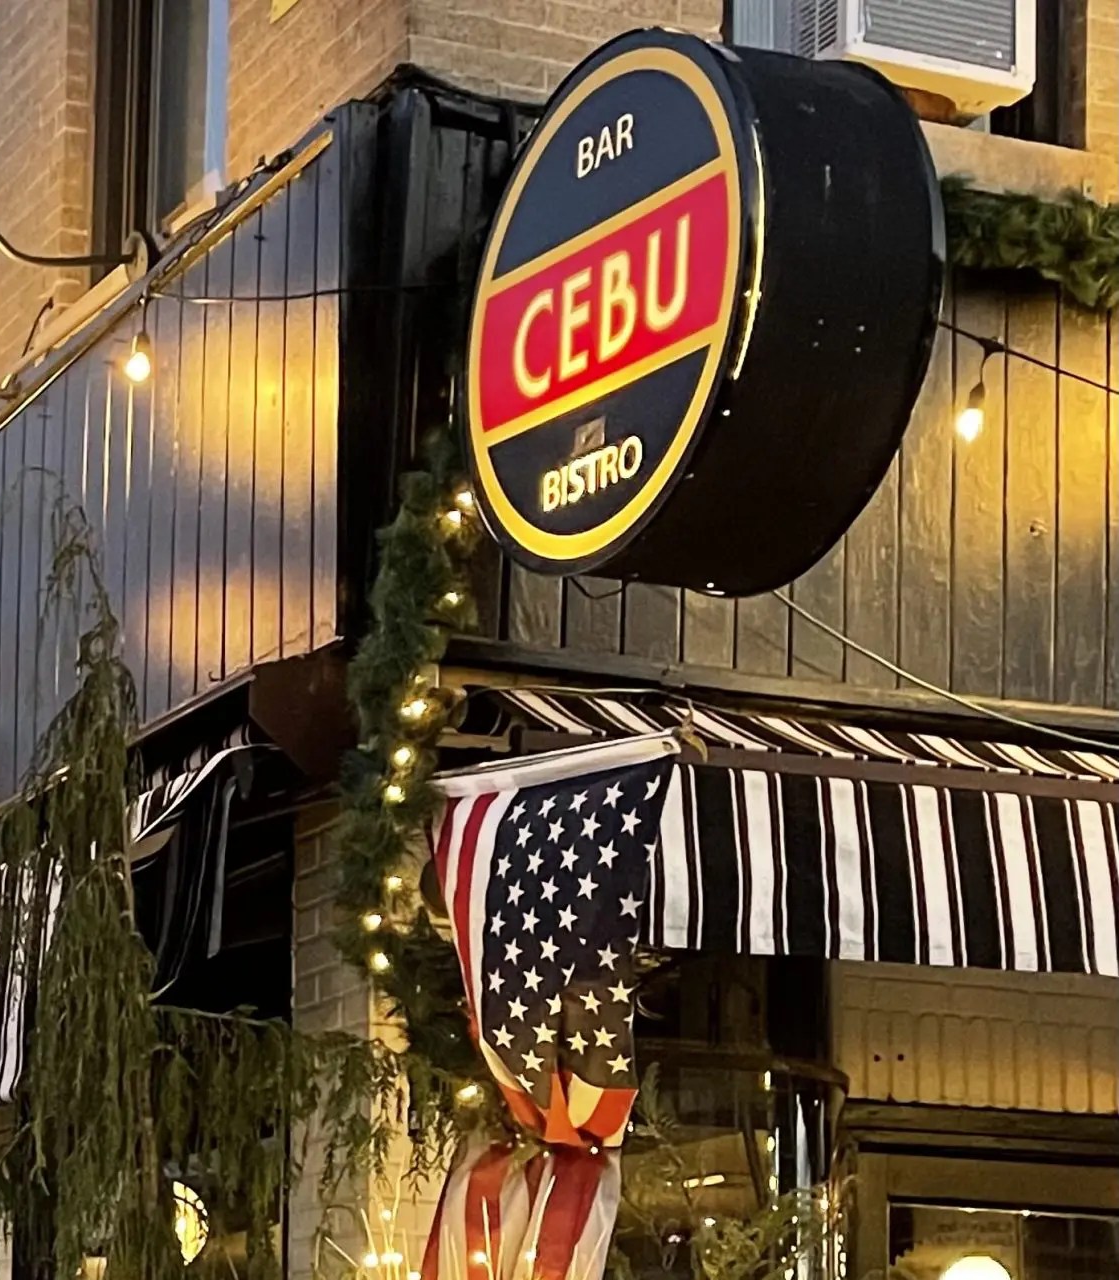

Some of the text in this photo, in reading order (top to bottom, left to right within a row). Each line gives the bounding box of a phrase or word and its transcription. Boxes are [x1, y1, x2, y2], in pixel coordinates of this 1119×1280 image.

[577, 113, 633, 178] BAR
[513, 213, 690, 398] CEBU
[543, 435, 643, 512] BISTRO
